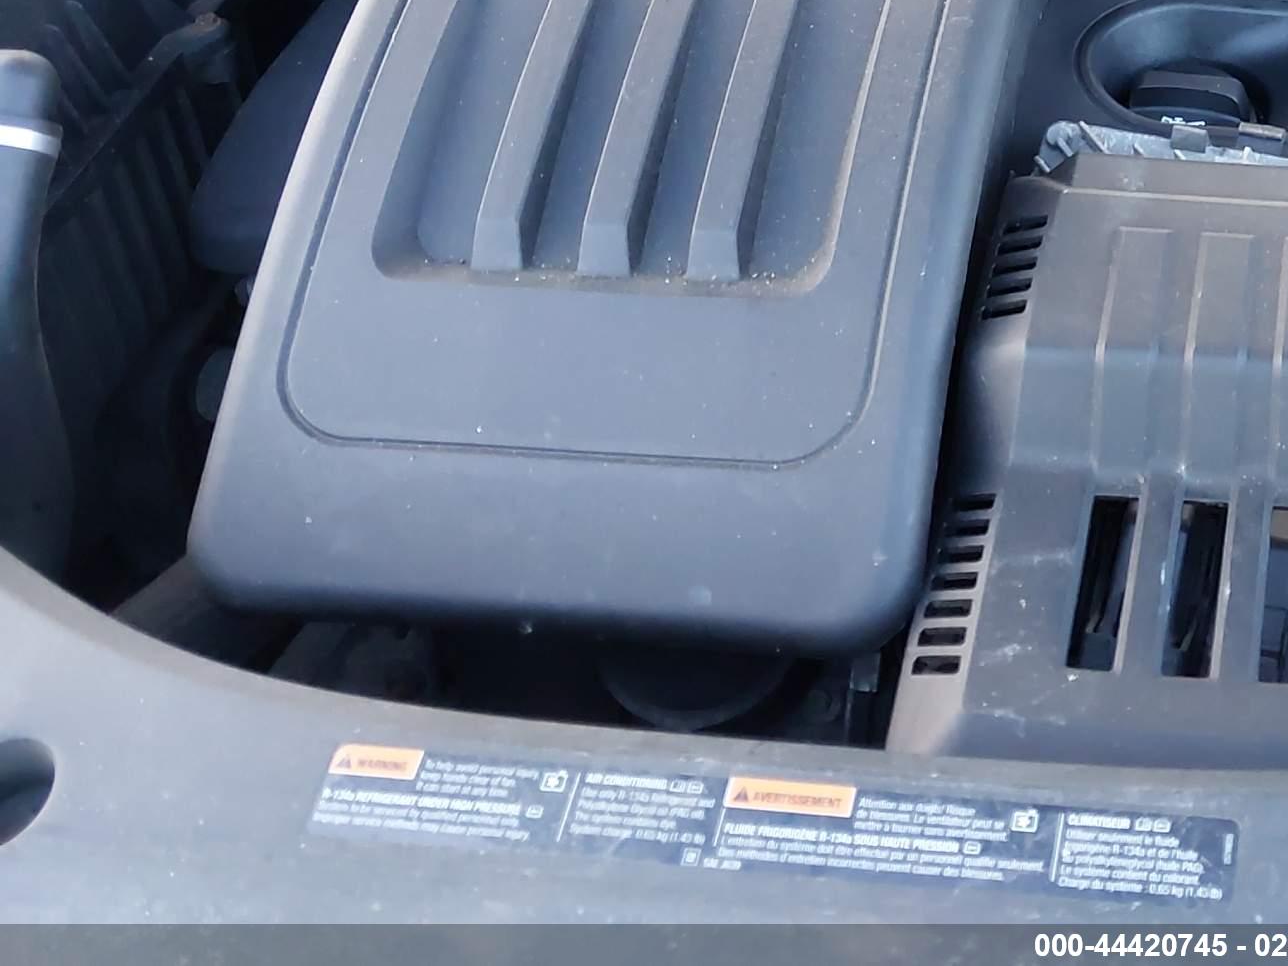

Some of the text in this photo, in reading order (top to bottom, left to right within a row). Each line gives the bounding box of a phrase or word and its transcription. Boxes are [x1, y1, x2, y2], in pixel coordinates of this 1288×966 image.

[358, 759, 408, 771] WARNING
[479, 765, 515, 777] personal
[585, 772, 668, 789] AIR CONDITIONING
[355, 791, 417, 806] REFRIGERANT
[417, 796, 450, 809] UNDER
[450, 799, 474, 811] HIGH
[598, 790, 618, 801] only
[698, 798, 716, 808] and
[752, 792, 843, 808] AVERTISSEMENT
[859, 798, 897, 810] Attention
[1067, 813, 1131, 829] CLIMATISEUR
[724, 822, 756, 835] FLUIDE
[819, 832, 852, 844] R-134a
[853, 834, 879, 846] SOUS
[880, 836, 911, 849] HAUTE
[912, 839, 960, 853] PRESSION
[1112, 844, 1145, 857] R-134a
